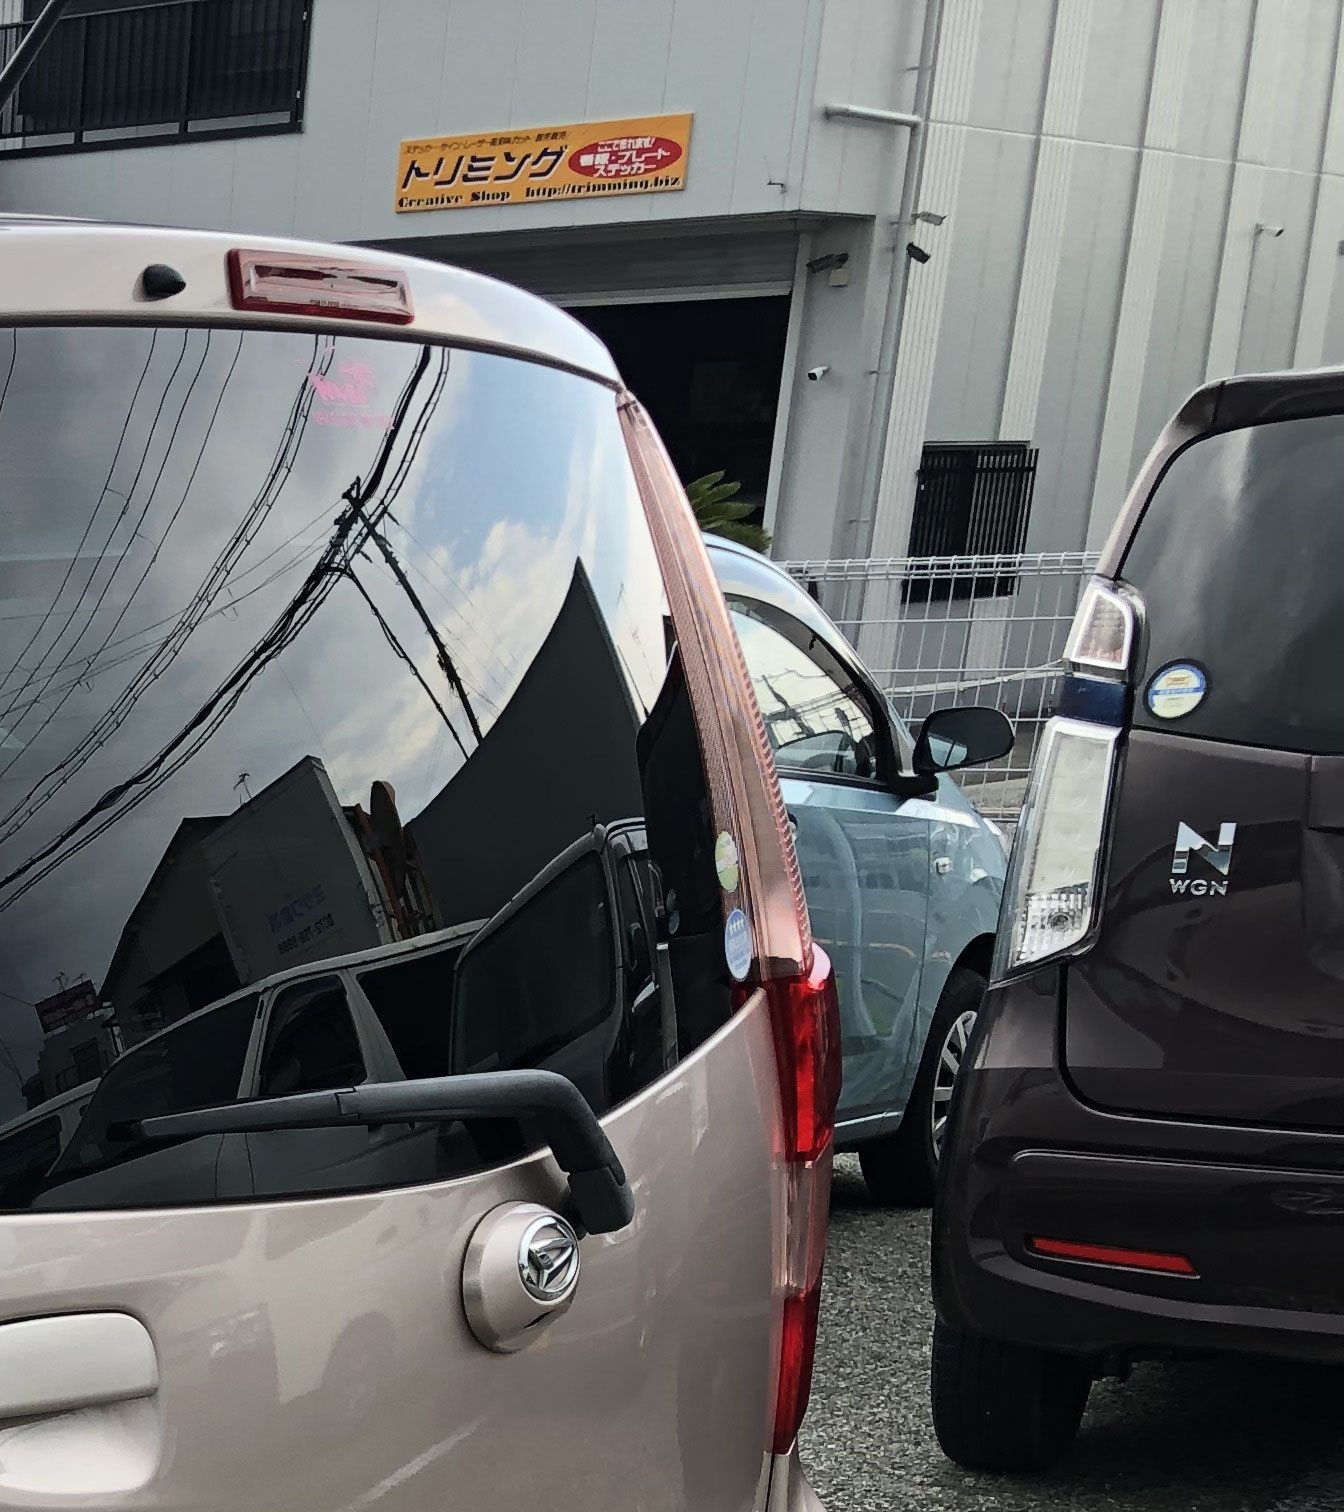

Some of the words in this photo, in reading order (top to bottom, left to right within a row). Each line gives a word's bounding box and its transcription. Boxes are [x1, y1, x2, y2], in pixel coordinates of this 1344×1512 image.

[401, 144, 570, 190] トリミング
[593, 162, 657, 178] ステッカー
[398, 192, 463, 208] Creative
[470, 189, 511, 203] Shop
[525, 175, 681, 198] http://trimming.biz
[1172, 821, 1238, 876] N
[1169, 878, 1229, 897] WGN
